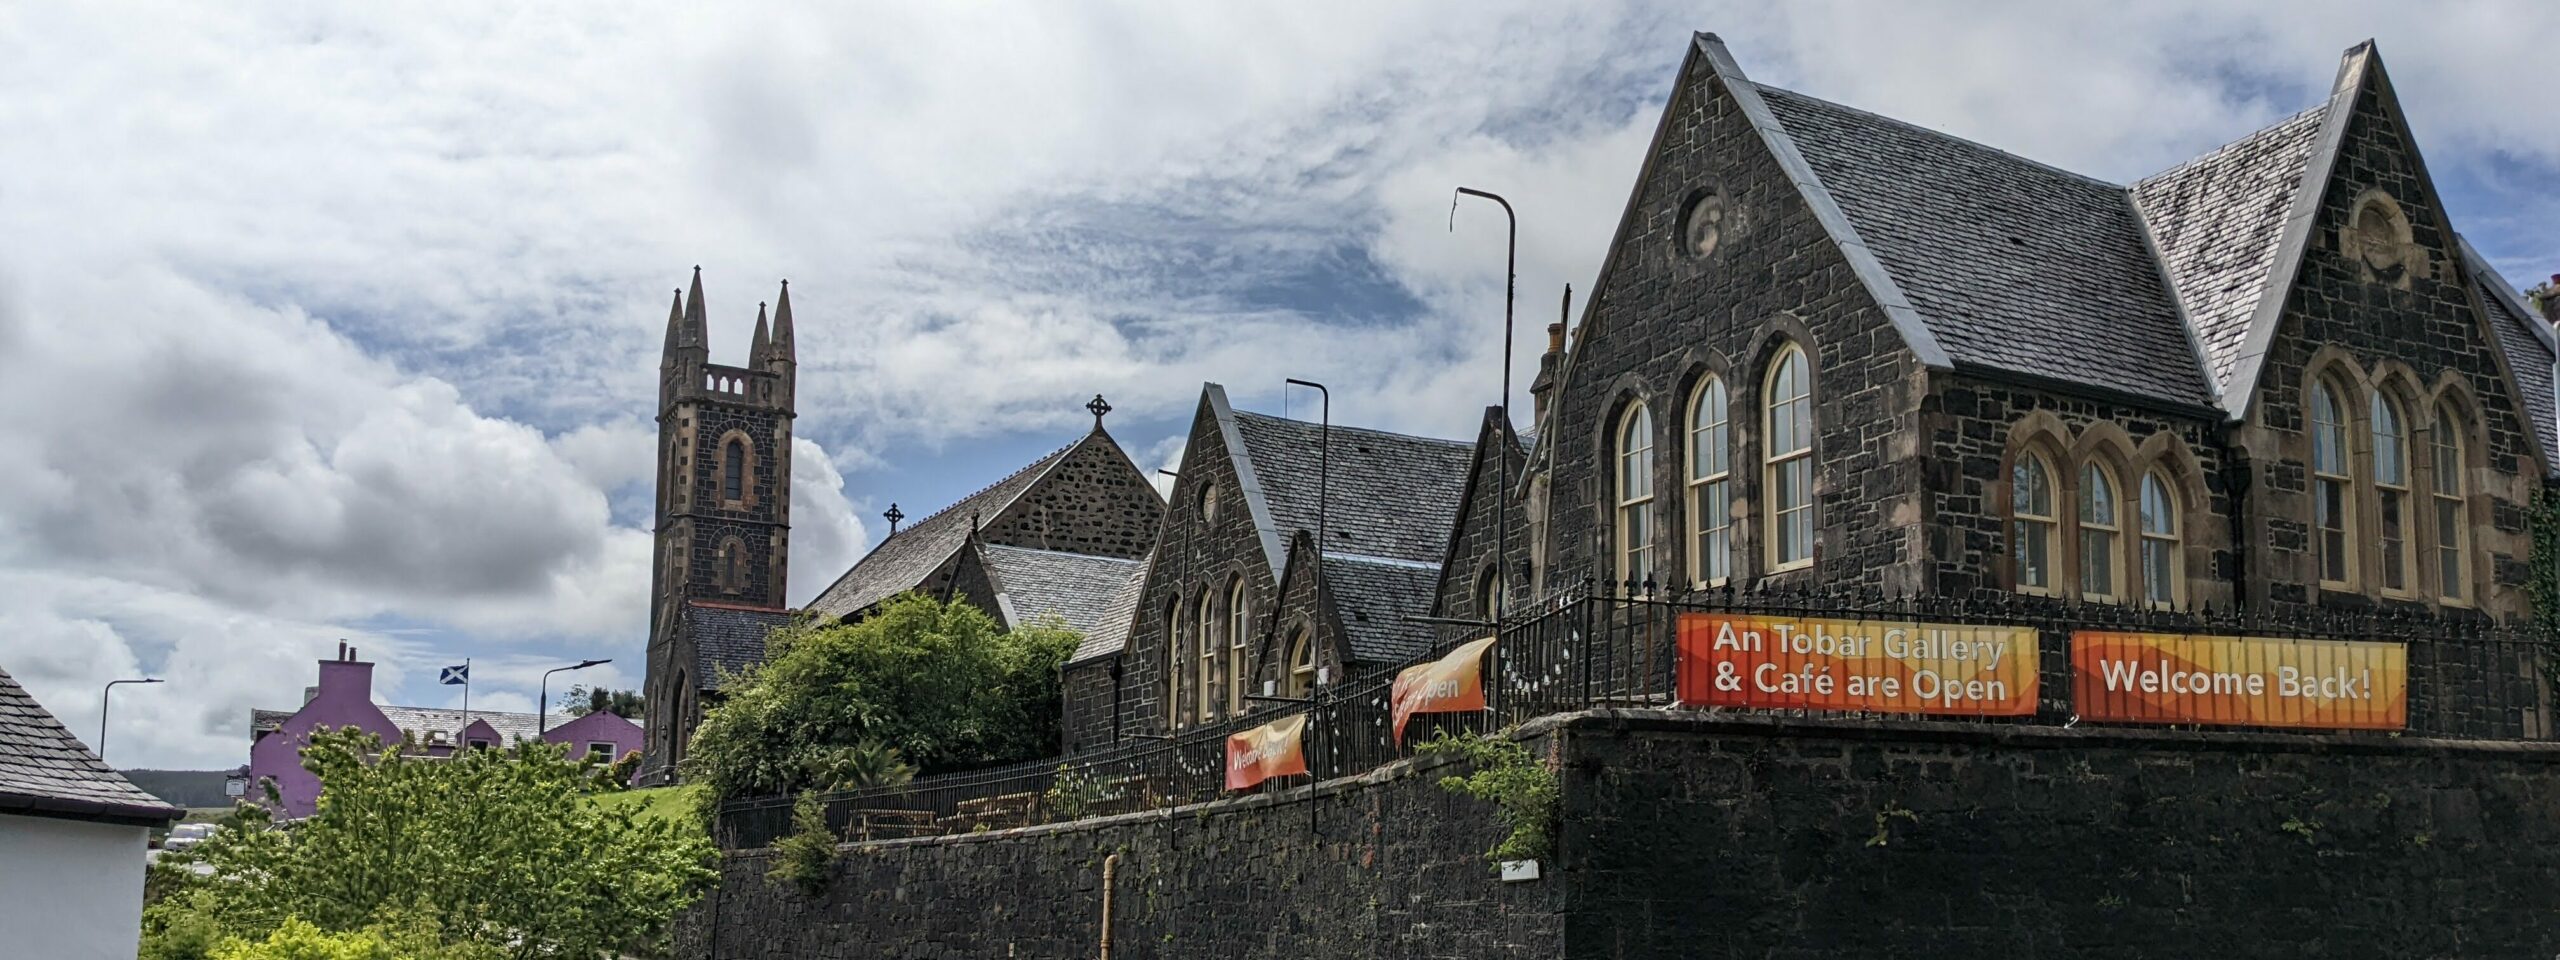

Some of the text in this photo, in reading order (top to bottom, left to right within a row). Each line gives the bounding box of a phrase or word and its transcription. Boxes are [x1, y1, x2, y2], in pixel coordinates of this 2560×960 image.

[1713, 622, 2004, 670] An Tobar Gallery
[1715, 661, 2005, 708] & Café are Open
[2100, 659, 2371, 699] Welcome Back!
